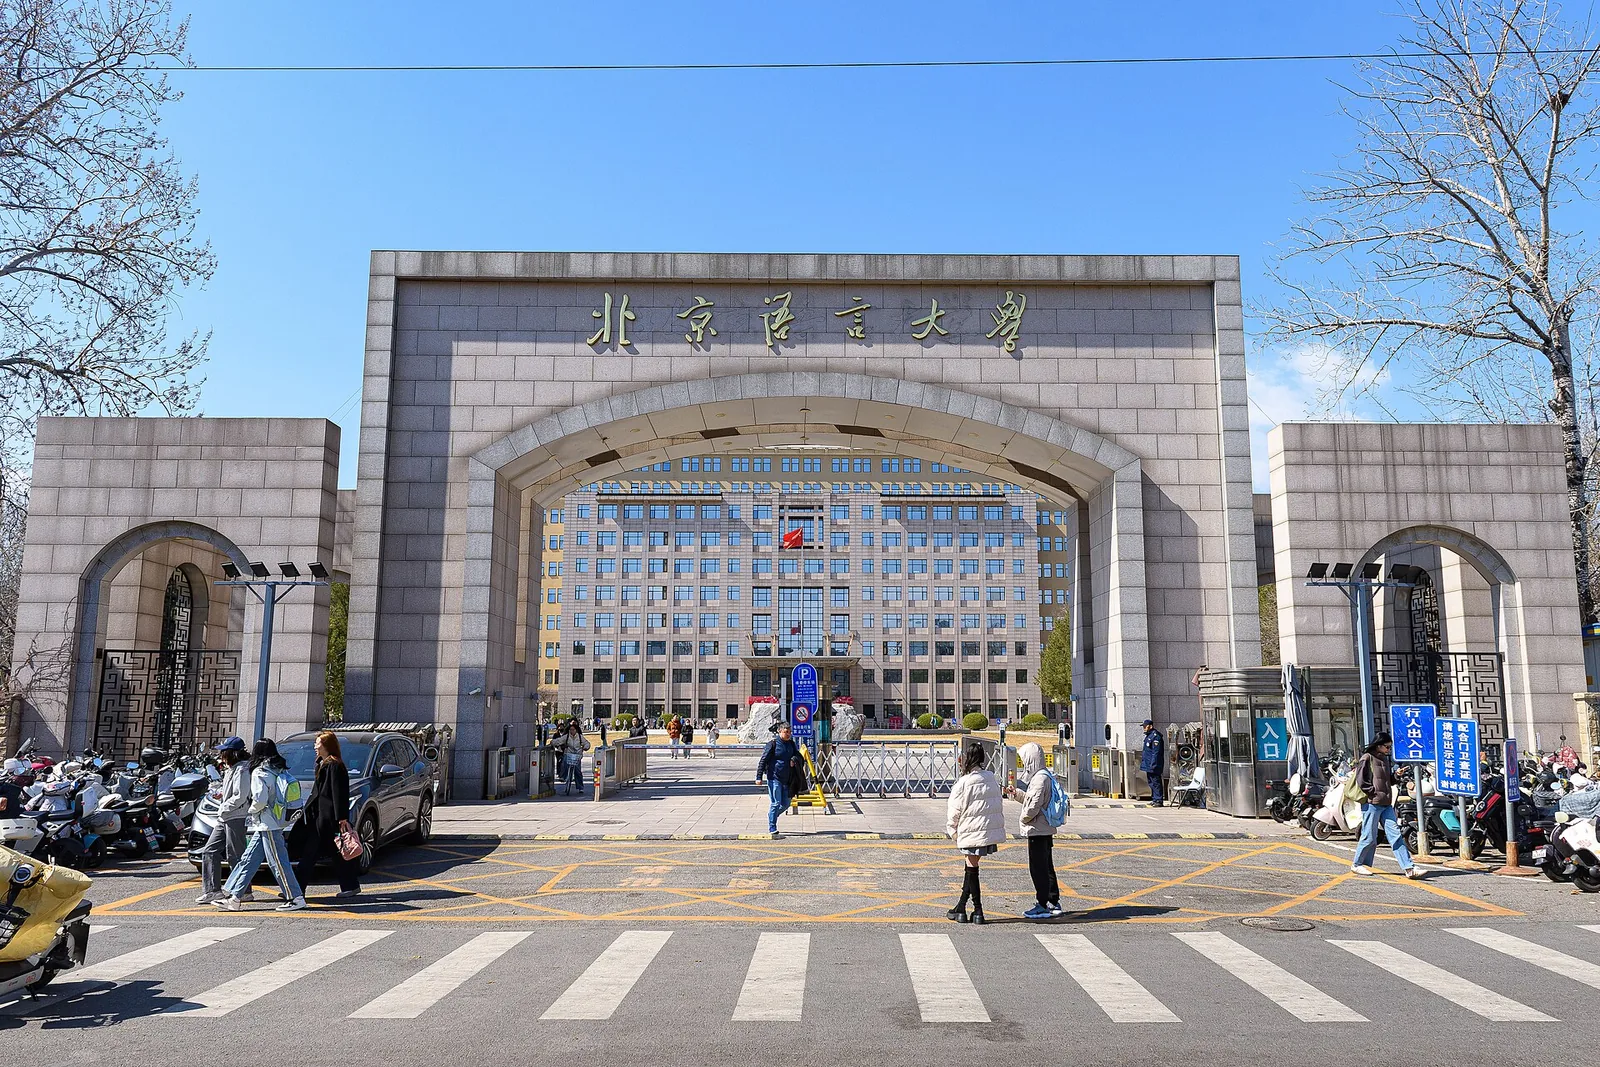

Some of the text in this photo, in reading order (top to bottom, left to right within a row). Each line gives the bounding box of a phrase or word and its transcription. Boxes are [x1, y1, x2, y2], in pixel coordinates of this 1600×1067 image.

[801, 669, 809, 679] P
[1261, 721, 1280, 759] 入口
[1405, 708, 1423, 759] 行人出入口
[1442, 722, 1455, 778] 请您出示证件
[1457, 723, 1471, 780] 配合门卫查证
[1440, 780, 1476, 792] 谢谢合作
